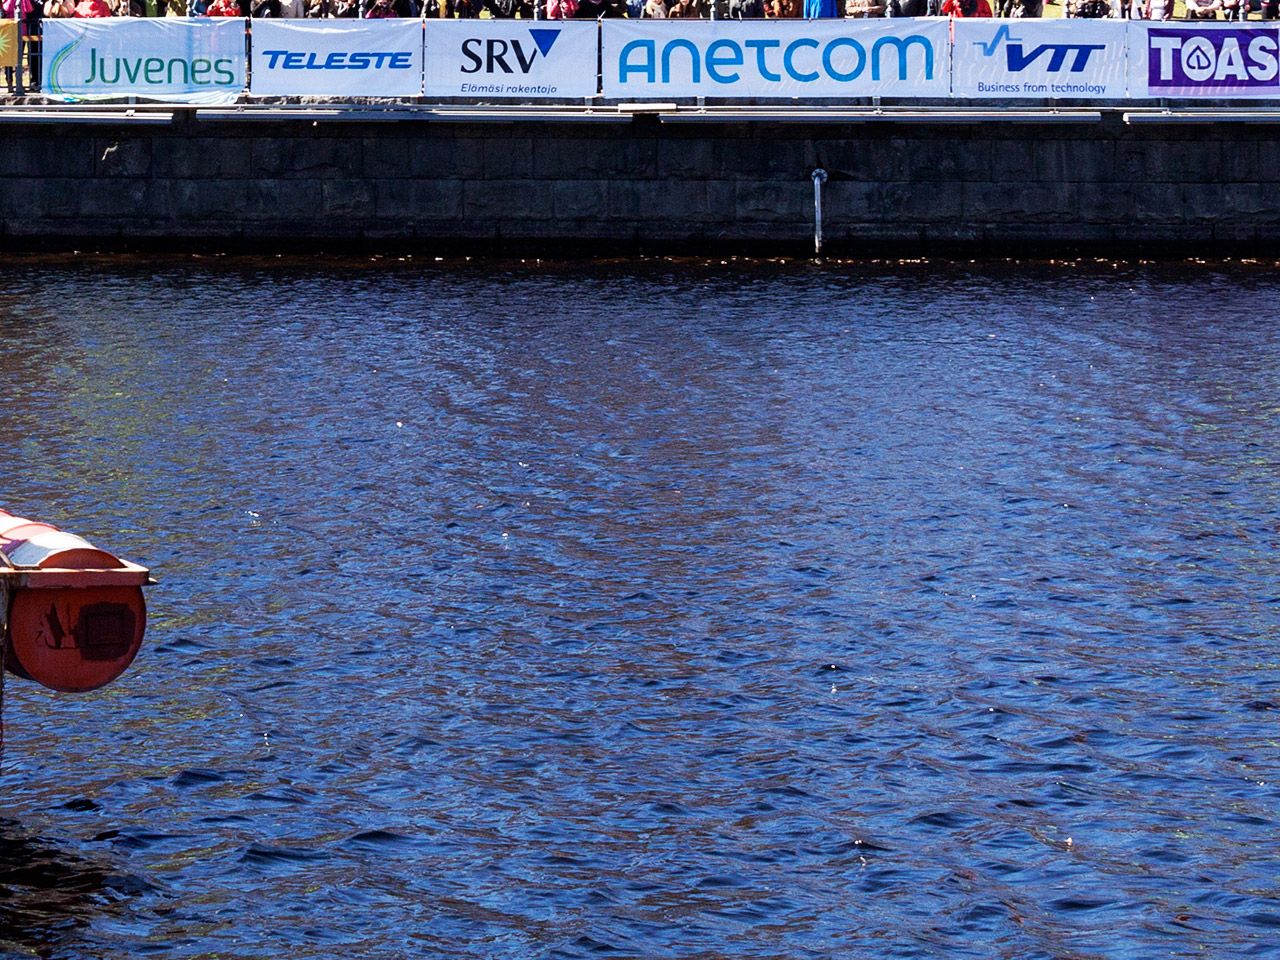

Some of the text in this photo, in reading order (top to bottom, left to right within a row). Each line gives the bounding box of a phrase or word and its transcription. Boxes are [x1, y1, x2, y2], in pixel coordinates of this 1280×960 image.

[85, 48, 235, 85] Juvenes
[262, 50, 413, 69] TELESTE
[460, 38, 538, 74] SRV
[1006, 43, 1106, 72] VTT
[1150, 35, 1279, 82] TOAS
[460, 83, 558, 95] Elämäsi rakentaja
[977, 81, 1107, 95] Business from technology
